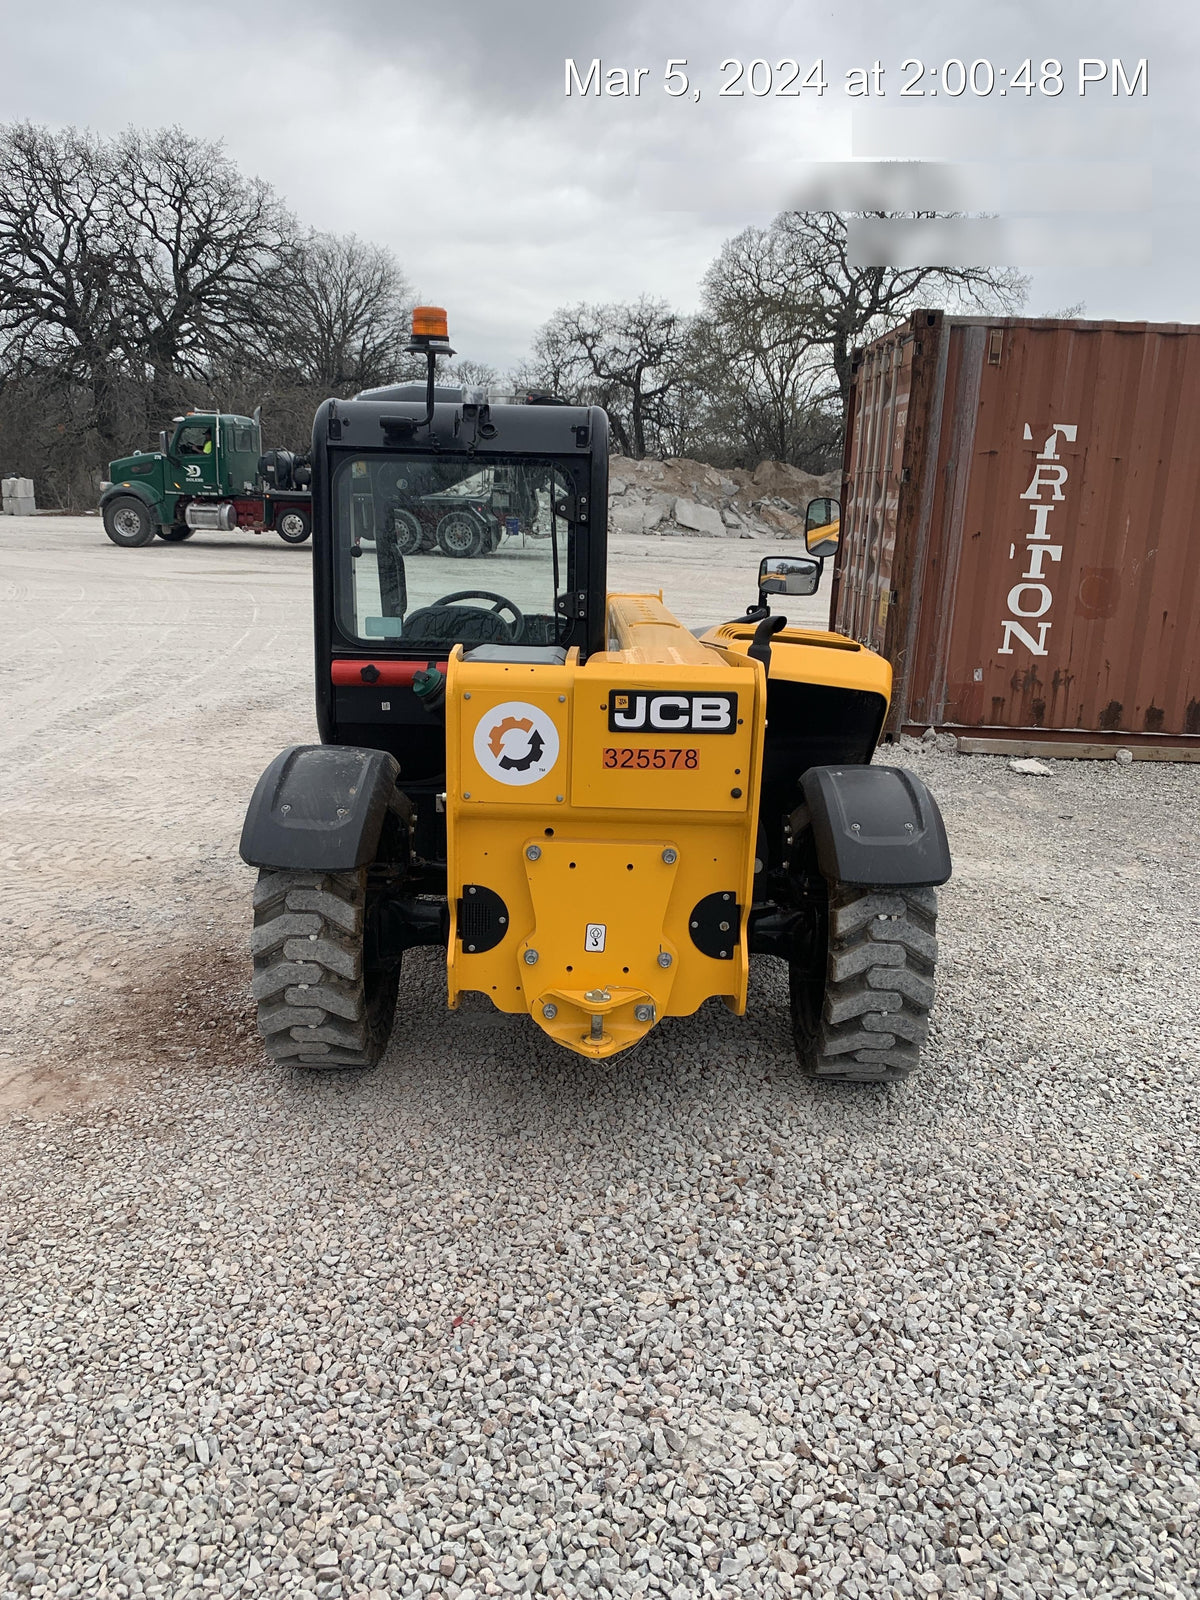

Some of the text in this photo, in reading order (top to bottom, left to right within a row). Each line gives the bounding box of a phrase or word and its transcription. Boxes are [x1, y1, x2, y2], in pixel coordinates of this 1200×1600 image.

[997, 422, 1078, 656] TRITON
[614, 695, 732, 729] JCB
[604, 748, 699, 769] 325578
